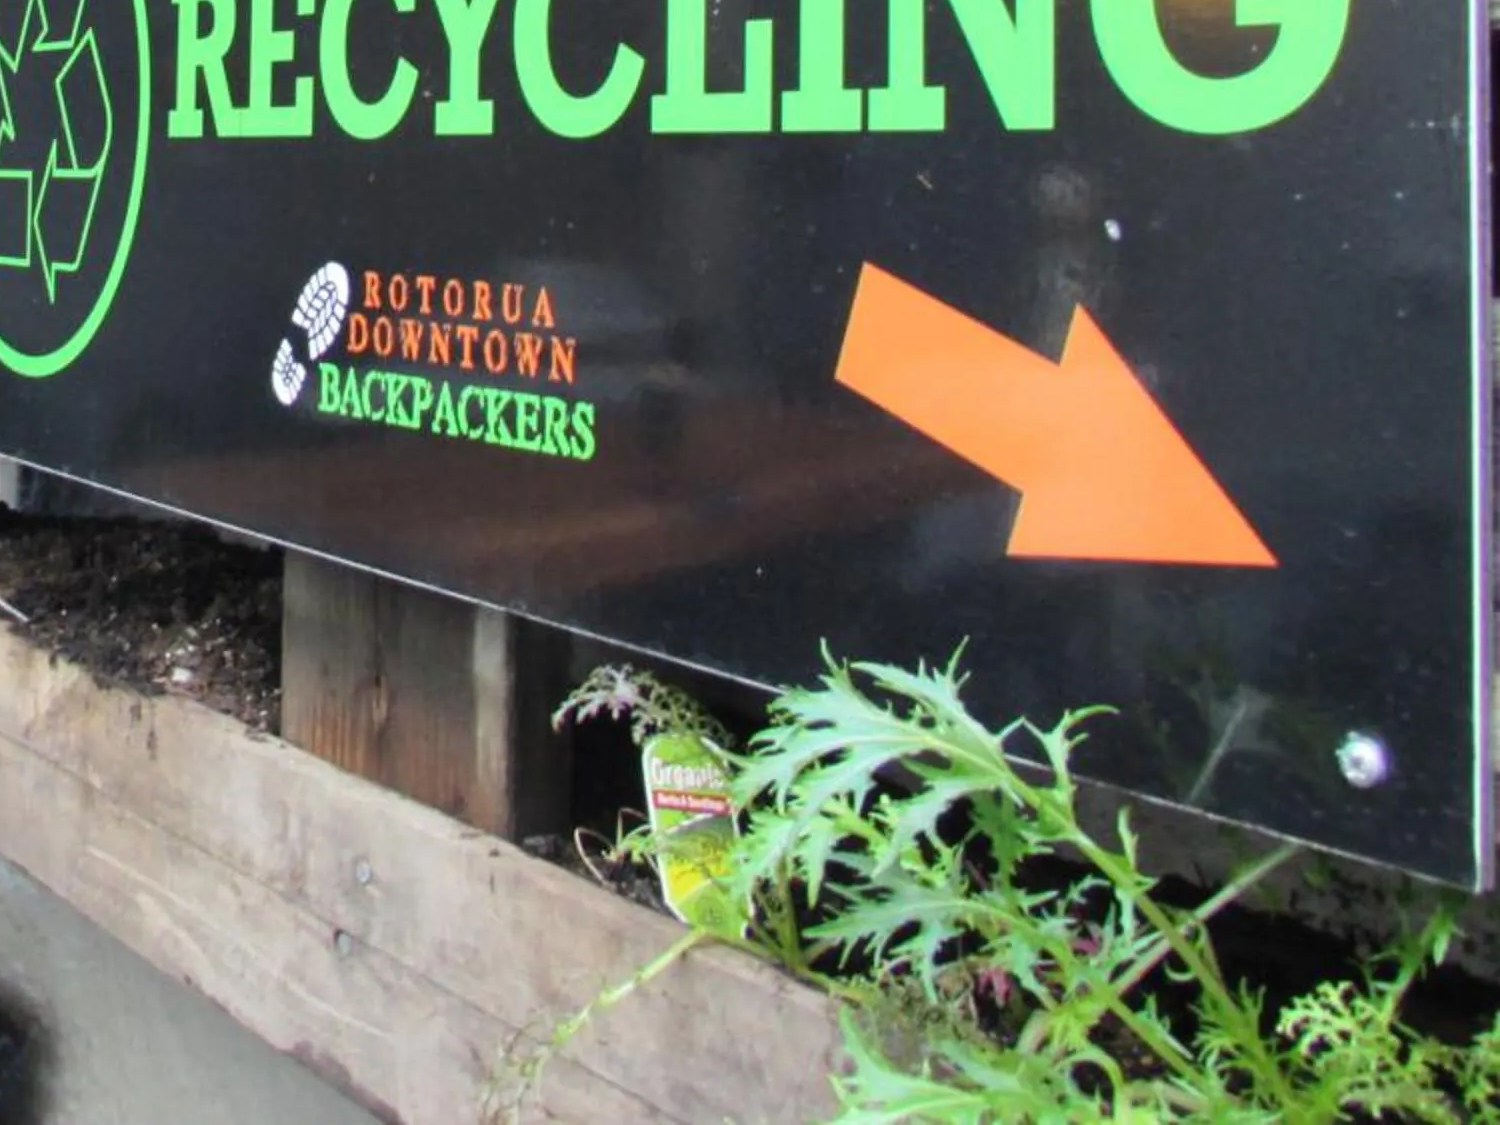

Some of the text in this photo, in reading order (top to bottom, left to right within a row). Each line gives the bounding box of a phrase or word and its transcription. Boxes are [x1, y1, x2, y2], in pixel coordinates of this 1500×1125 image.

[363, 270, 555, 328] ROTORUA
[346, 313, 577, 384] DOWNTOWN
[316, 362, 596, 461] BACKPACKERS
